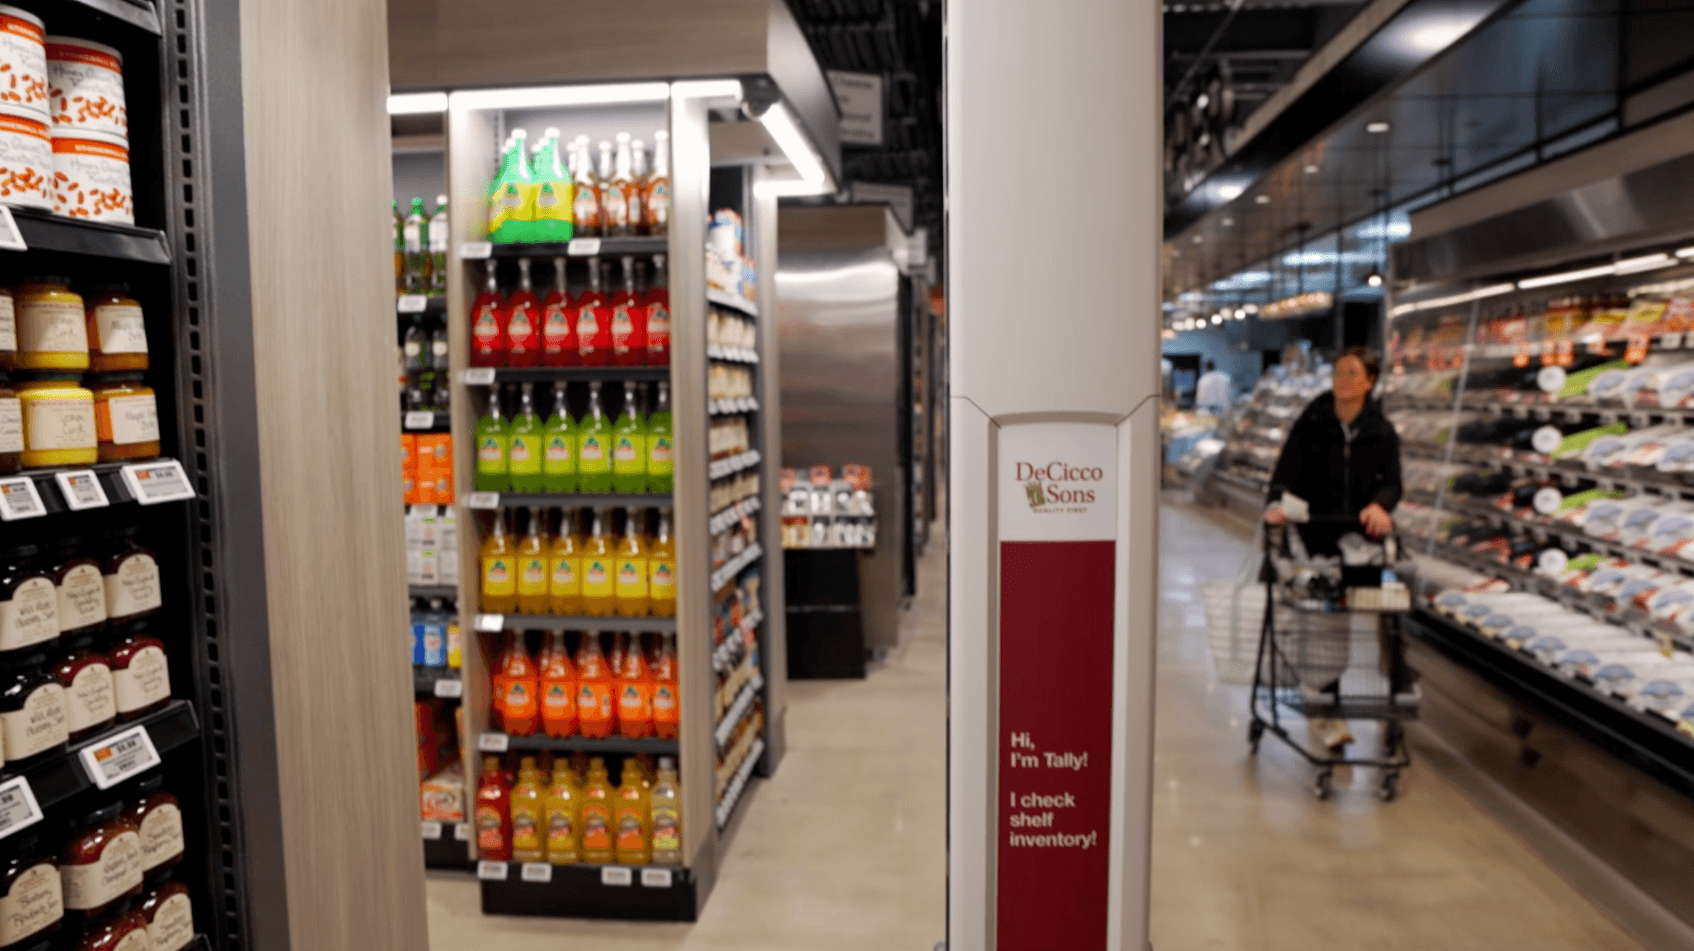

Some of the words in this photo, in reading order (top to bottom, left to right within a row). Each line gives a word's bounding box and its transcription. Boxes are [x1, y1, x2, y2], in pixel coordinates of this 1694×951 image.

[1016, 461, 1103, 481] DeCicco
[1047, 483, 1096, 504] Sons
[1010, 731, 1036, 751] Hi,
[1010, 751, 1039, 768] I'm
[1043, 751, 1088, 771] Tally!
[1010, 791, 1016, 808] I
[1020, 791, 1076, 808] check
[1009, 811, 1054, 828] shelf
[1009, 830, 1097, 850] inventory!
